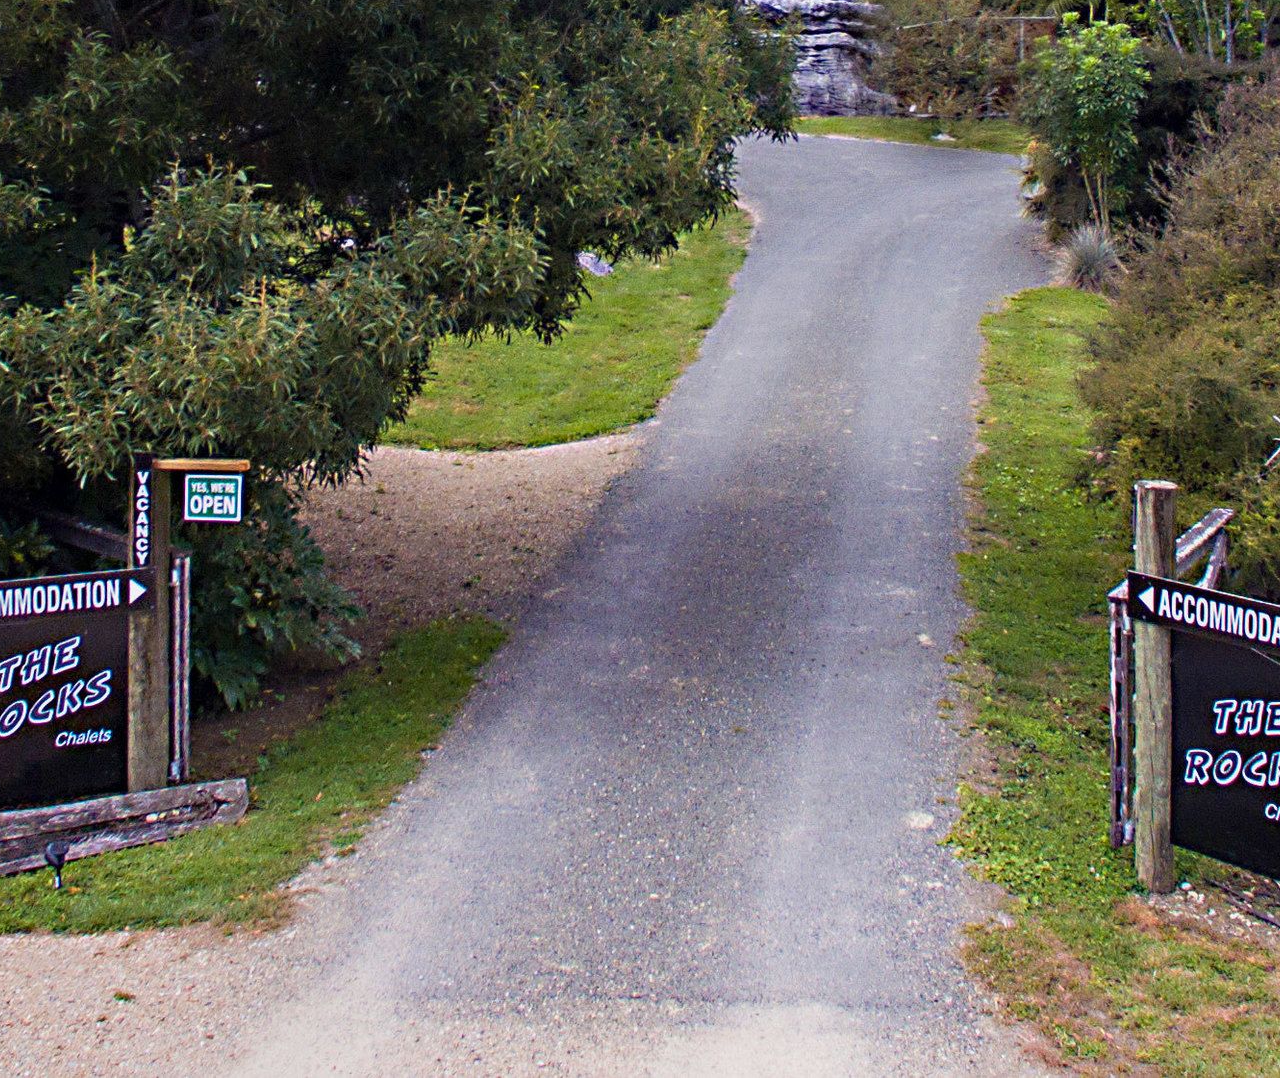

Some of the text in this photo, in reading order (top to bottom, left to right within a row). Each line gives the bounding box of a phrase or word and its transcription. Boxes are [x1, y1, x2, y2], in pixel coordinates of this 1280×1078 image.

[190, 495, 236, 515] OPEN
[136, 471, 150, 565] VACANCY
[55, 728, 113, 748] Chalets
